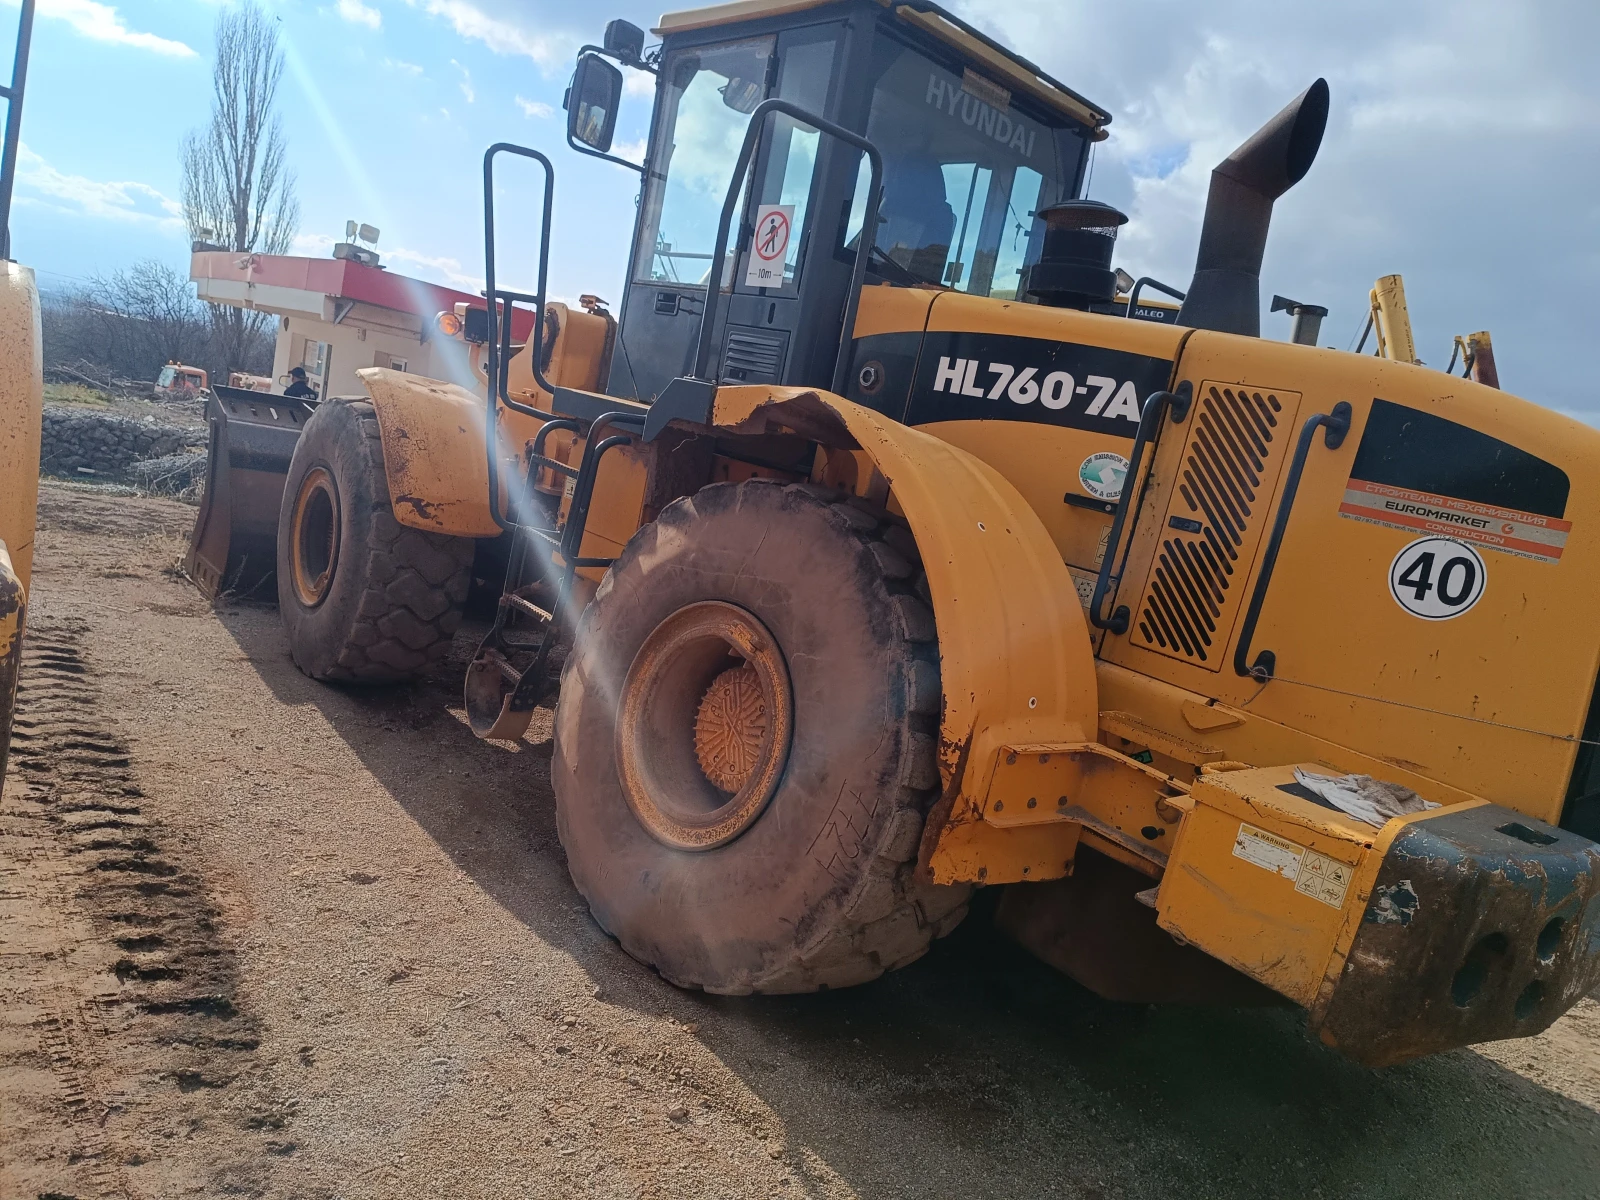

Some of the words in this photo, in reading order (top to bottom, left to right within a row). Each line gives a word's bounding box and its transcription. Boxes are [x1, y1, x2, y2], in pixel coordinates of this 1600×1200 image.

[925, 73, 1036, 158] HYUNDAI
[757, 268, 772, 279] 10m
[933, 356, 1141, 423] HL760-7A
[1365, 484, 1443, 506] СТРОИТЕЛНА
[1446, 499, 1548, 526] МЕХАНИЗАЦИЯ
[1385, 501, 1491, 529] EUROMARKET
[1425, 522, 1505, 544] CONSTRUCTION
[1397, 551, 1476, 607] 40
[1260, 833, 1290, 850] WARNING
